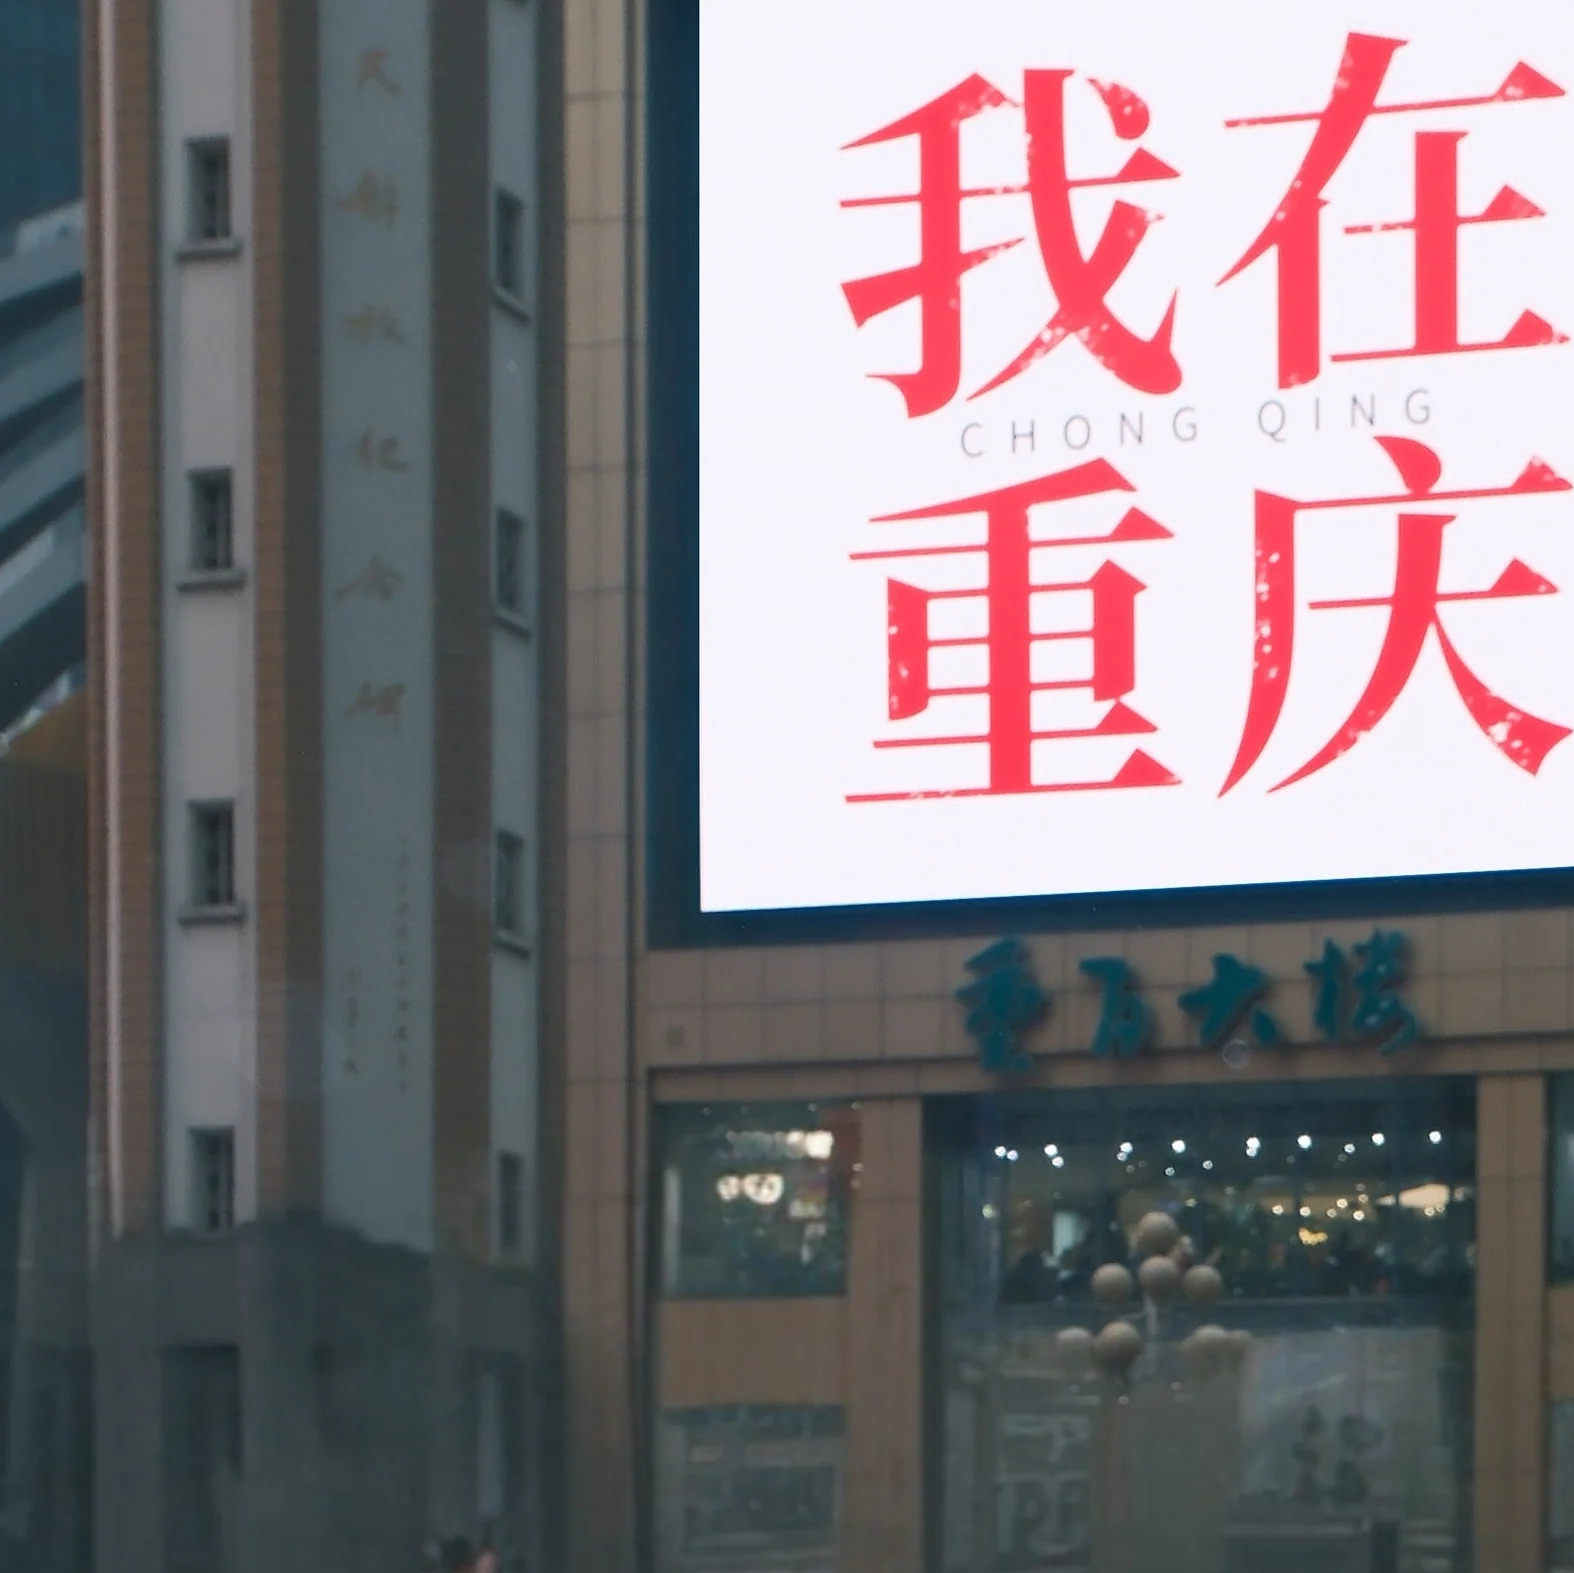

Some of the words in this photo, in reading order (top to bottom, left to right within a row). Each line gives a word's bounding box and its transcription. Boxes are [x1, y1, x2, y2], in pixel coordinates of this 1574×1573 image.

[838, 31, 1570, 419] 我在
[959, 405, 1199, 459] CHONG
[1256, 387, 1432, 443] QING
[844, 434, 1574, 804] 重庆
